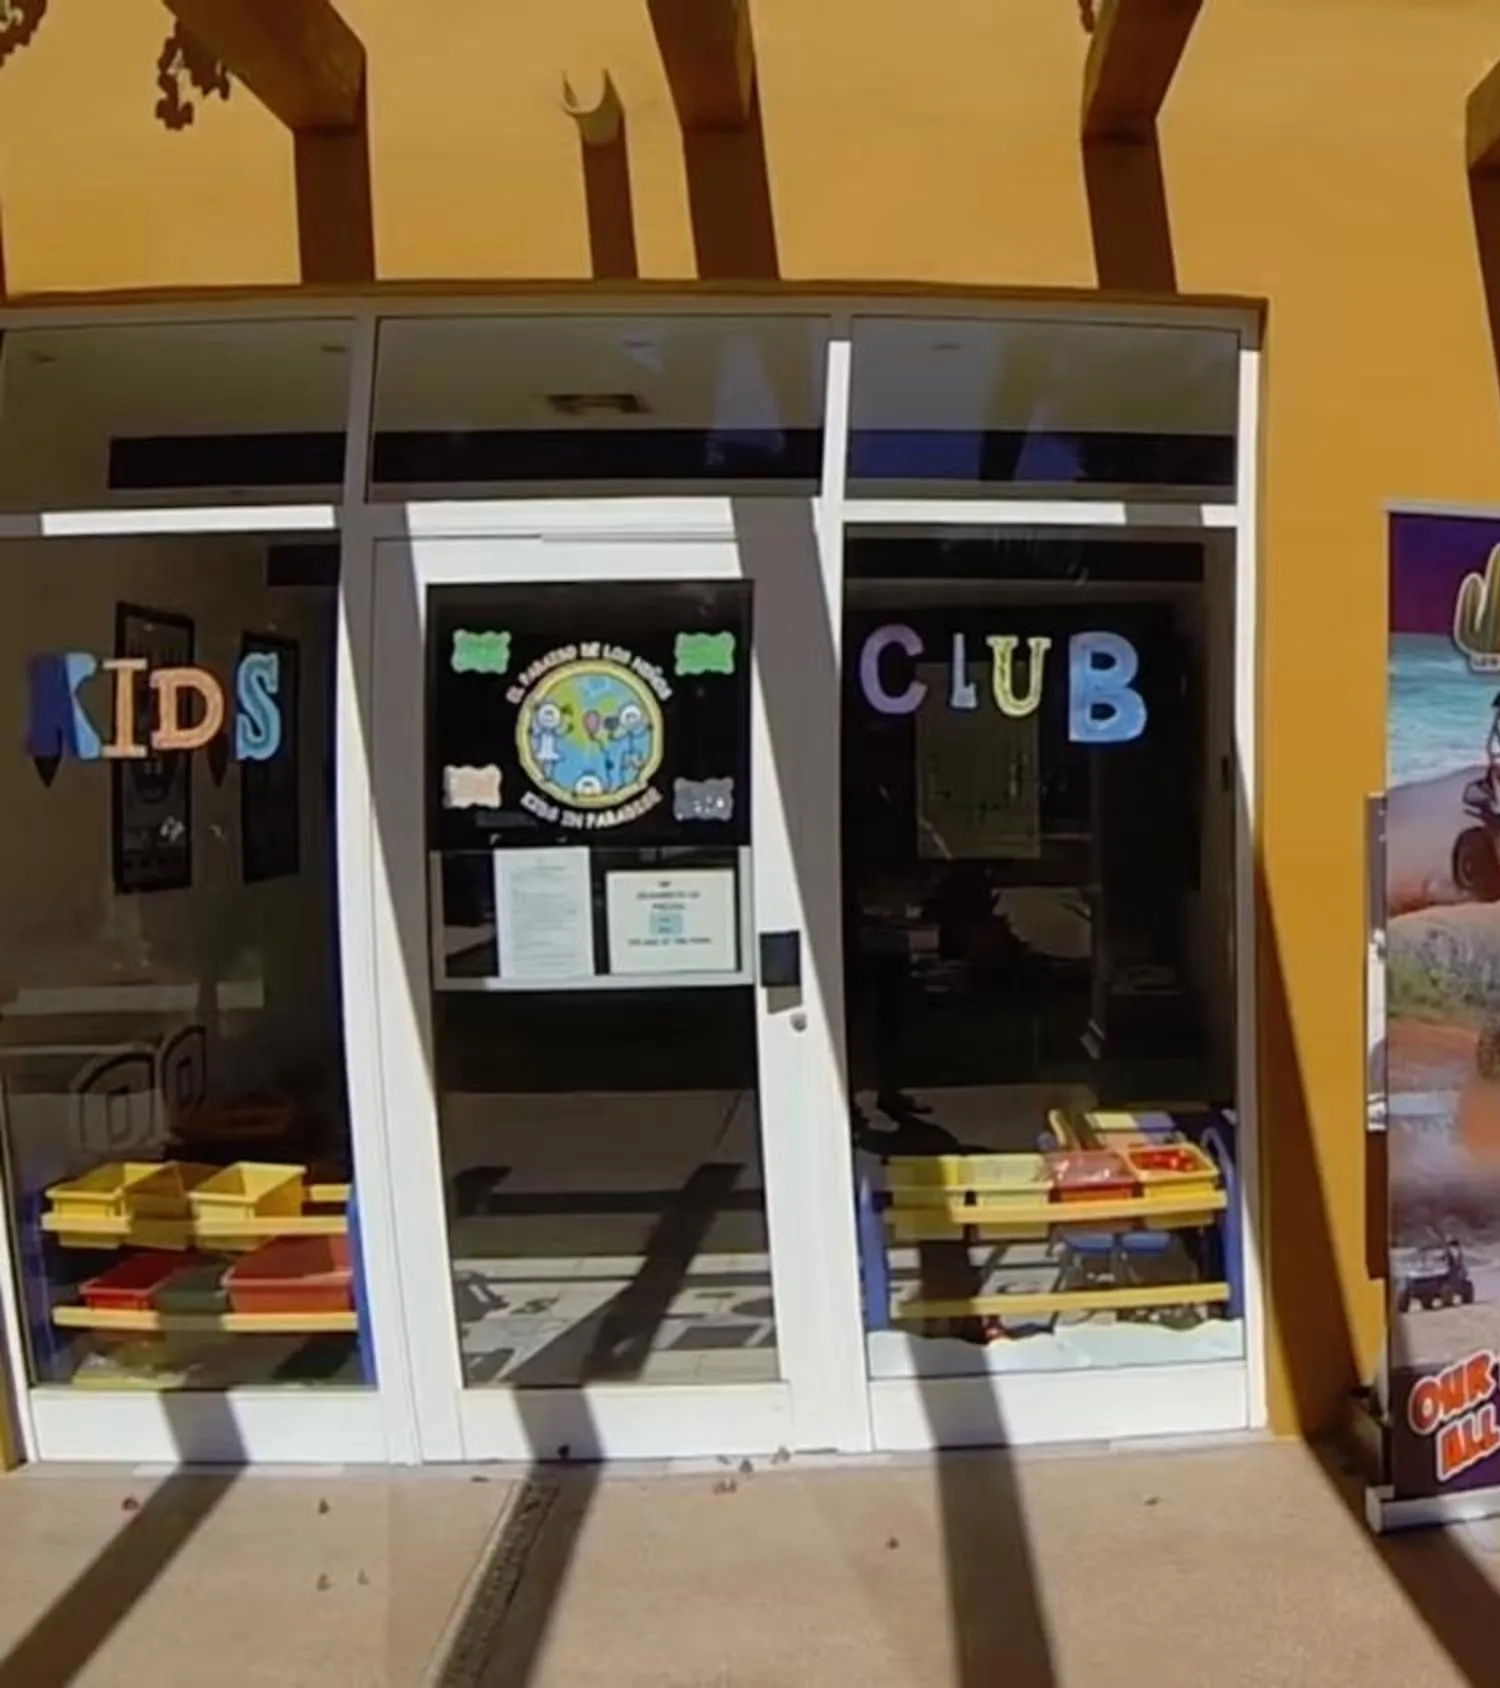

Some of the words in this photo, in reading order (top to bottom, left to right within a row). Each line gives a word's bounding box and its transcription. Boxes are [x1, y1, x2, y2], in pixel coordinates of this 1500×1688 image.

[28, 652, 282, 762] KIDS
[860, 623, 1148, 743] CLUB
[1409, 1350, 1497, 1434] OUR
